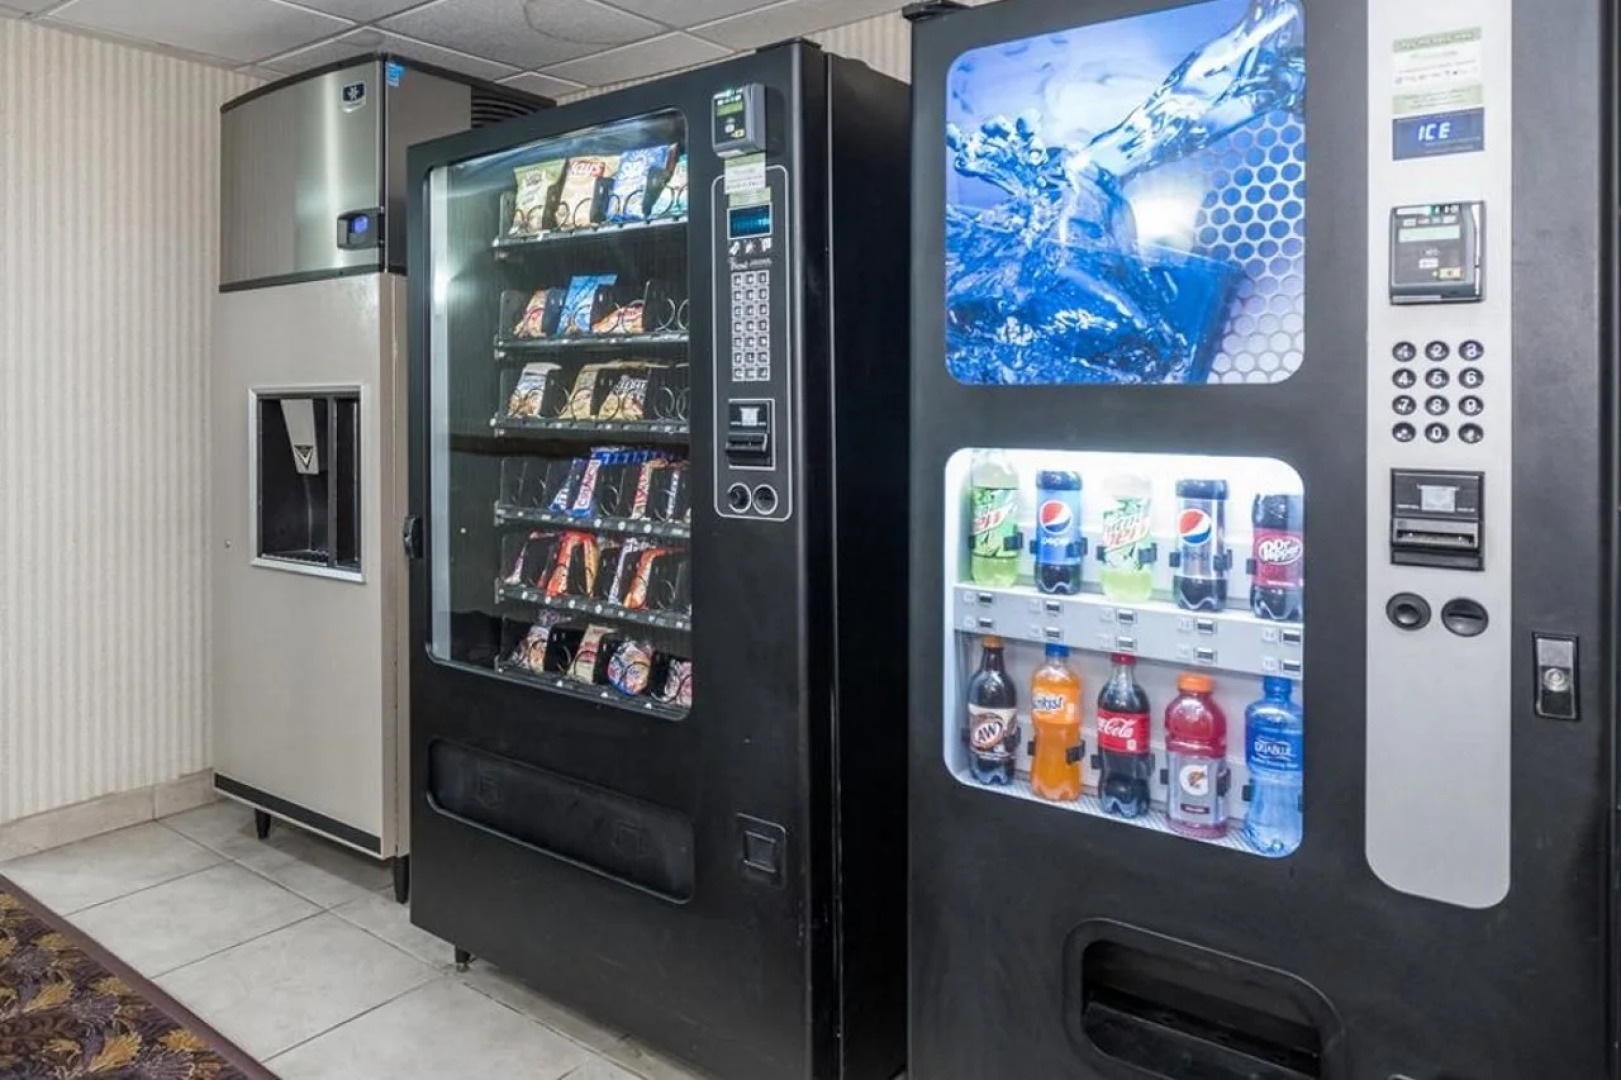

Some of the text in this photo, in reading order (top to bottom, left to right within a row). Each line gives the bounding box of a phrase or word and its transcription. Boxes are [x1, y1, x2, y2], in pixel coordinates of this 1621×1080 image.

[1417, 122, 1451, 142] ICE
[1466, 371, 1477, 385] 6
[1465, 398, 1477, 413] 9
